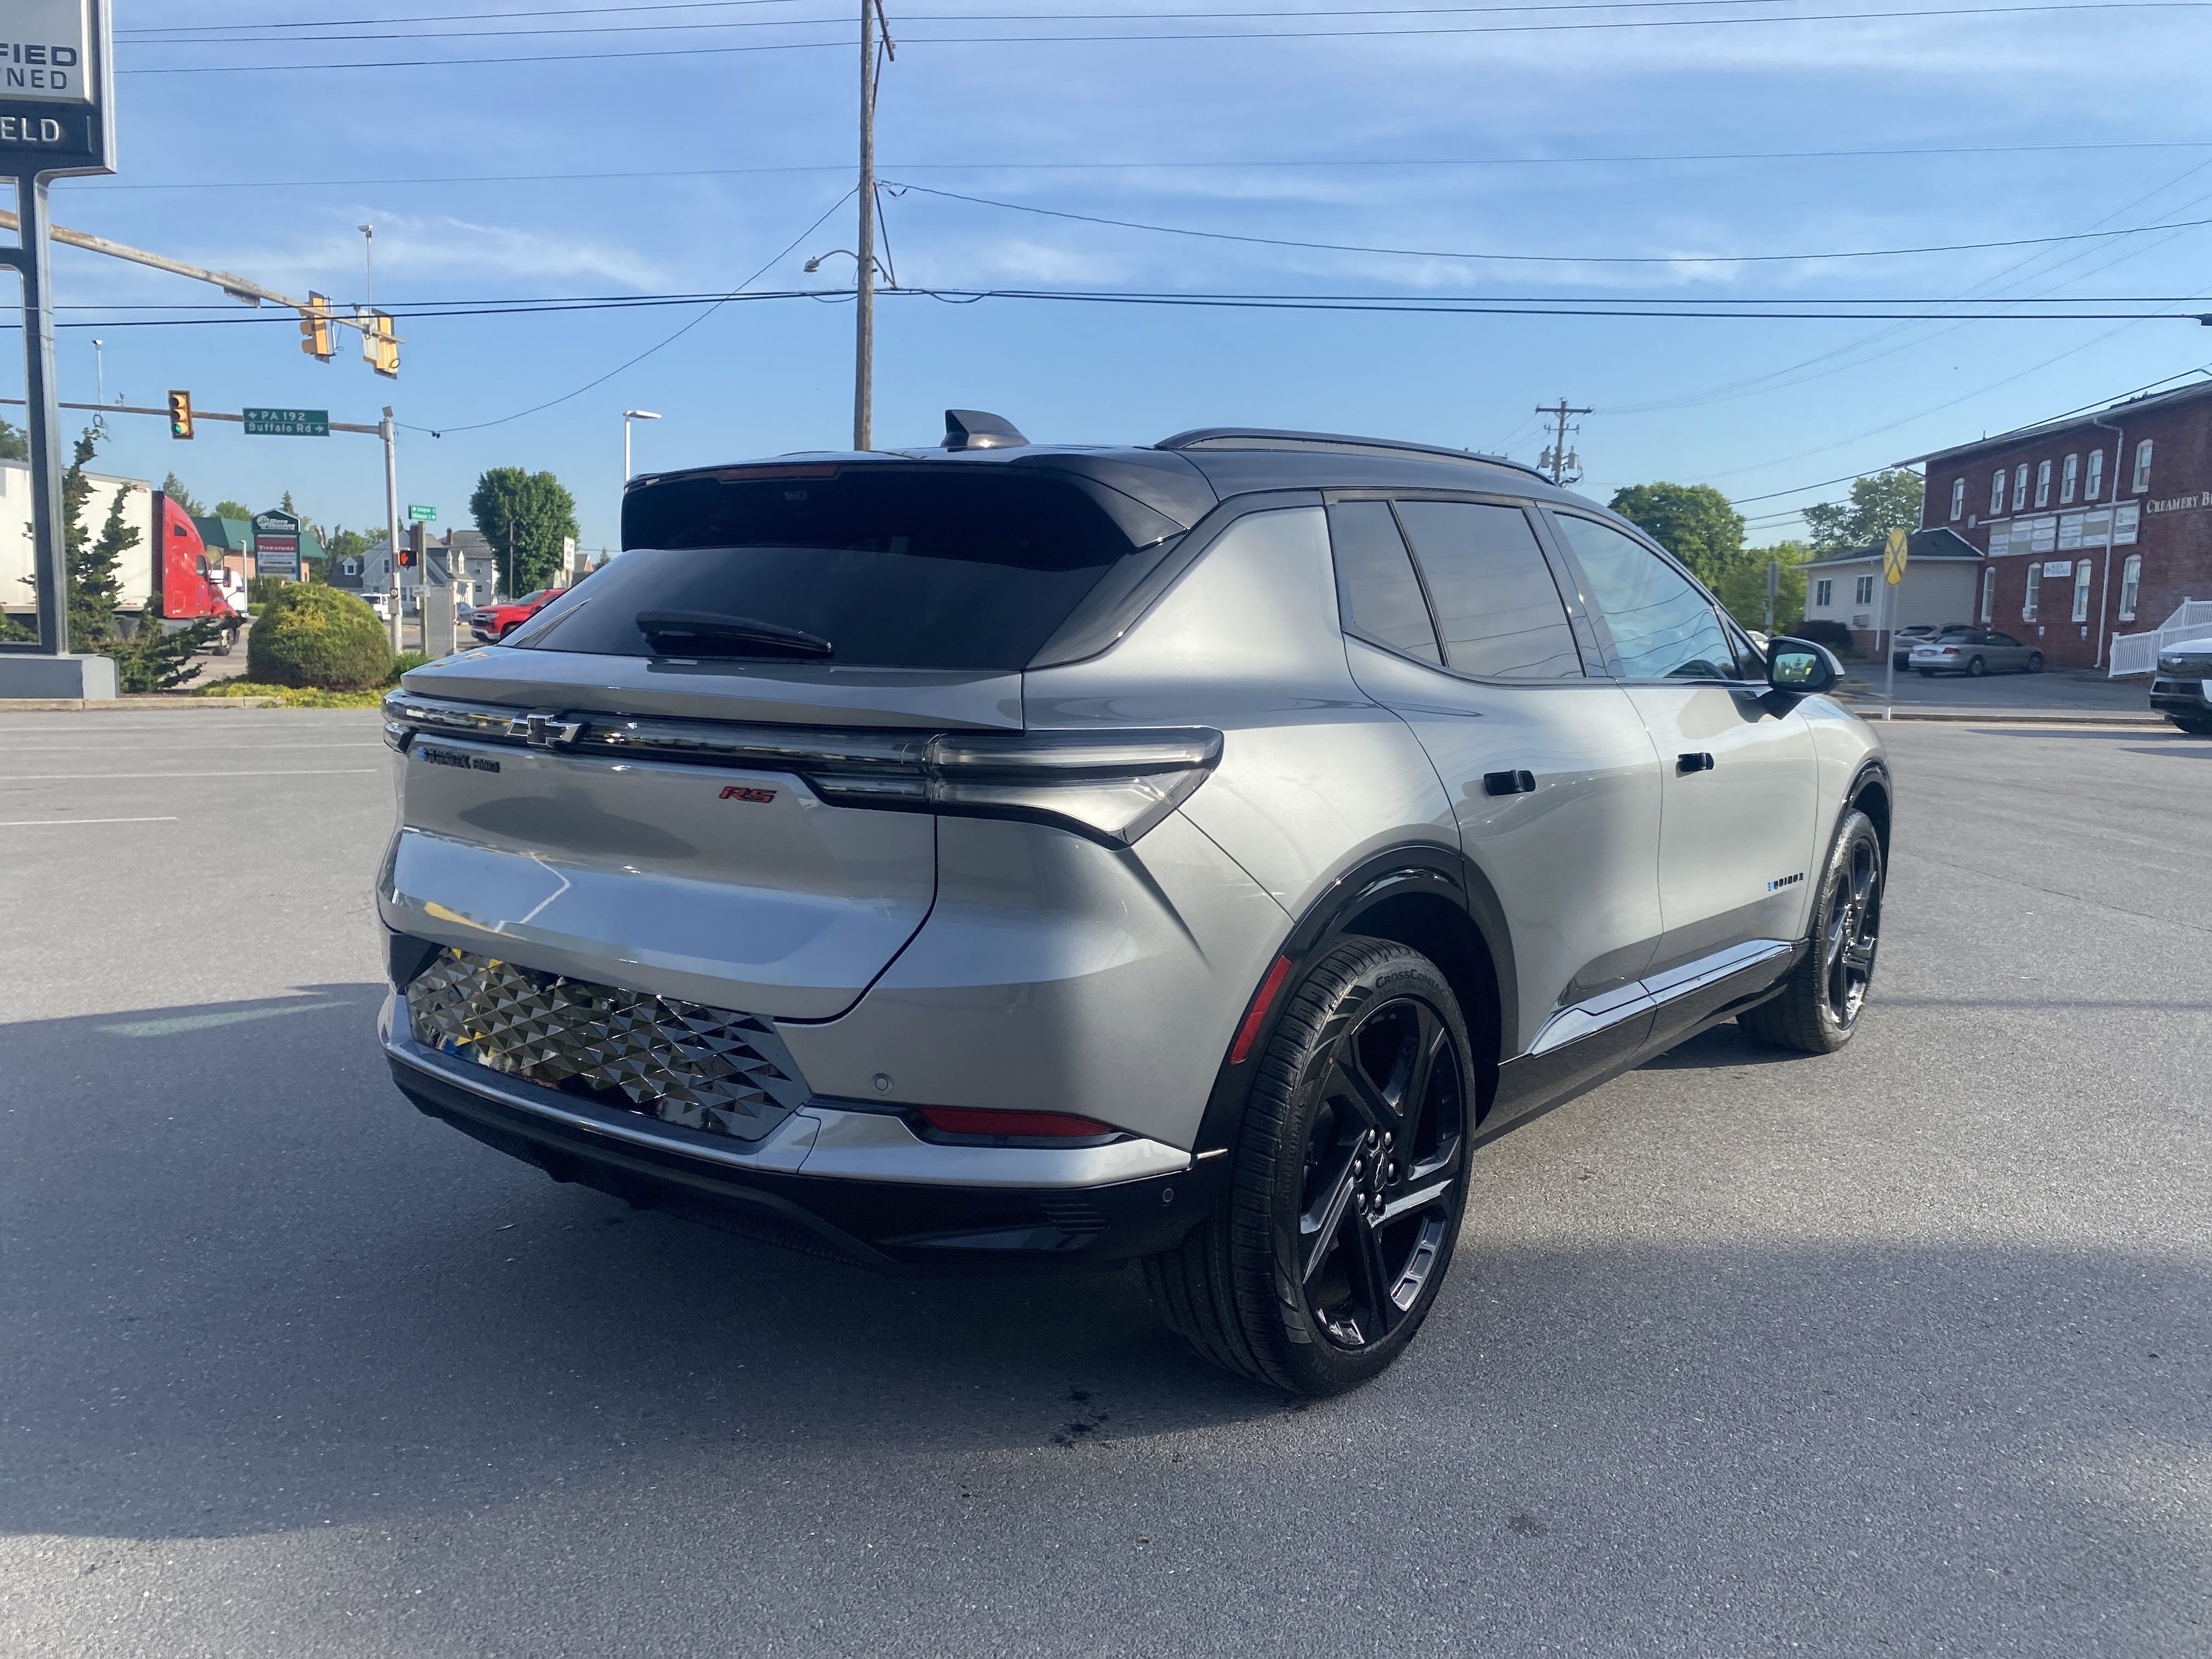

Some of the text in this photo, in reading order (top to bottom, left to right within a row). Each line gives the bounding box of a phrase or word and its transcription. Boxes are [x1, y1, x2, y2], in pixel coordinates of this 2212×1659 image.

[0, 116, 59, 142] ELD
[261, 411, 306, 421] PA 192
[249, 422, 311, 433] Buffalo Rd
[719, 786, 777, 804] RS
